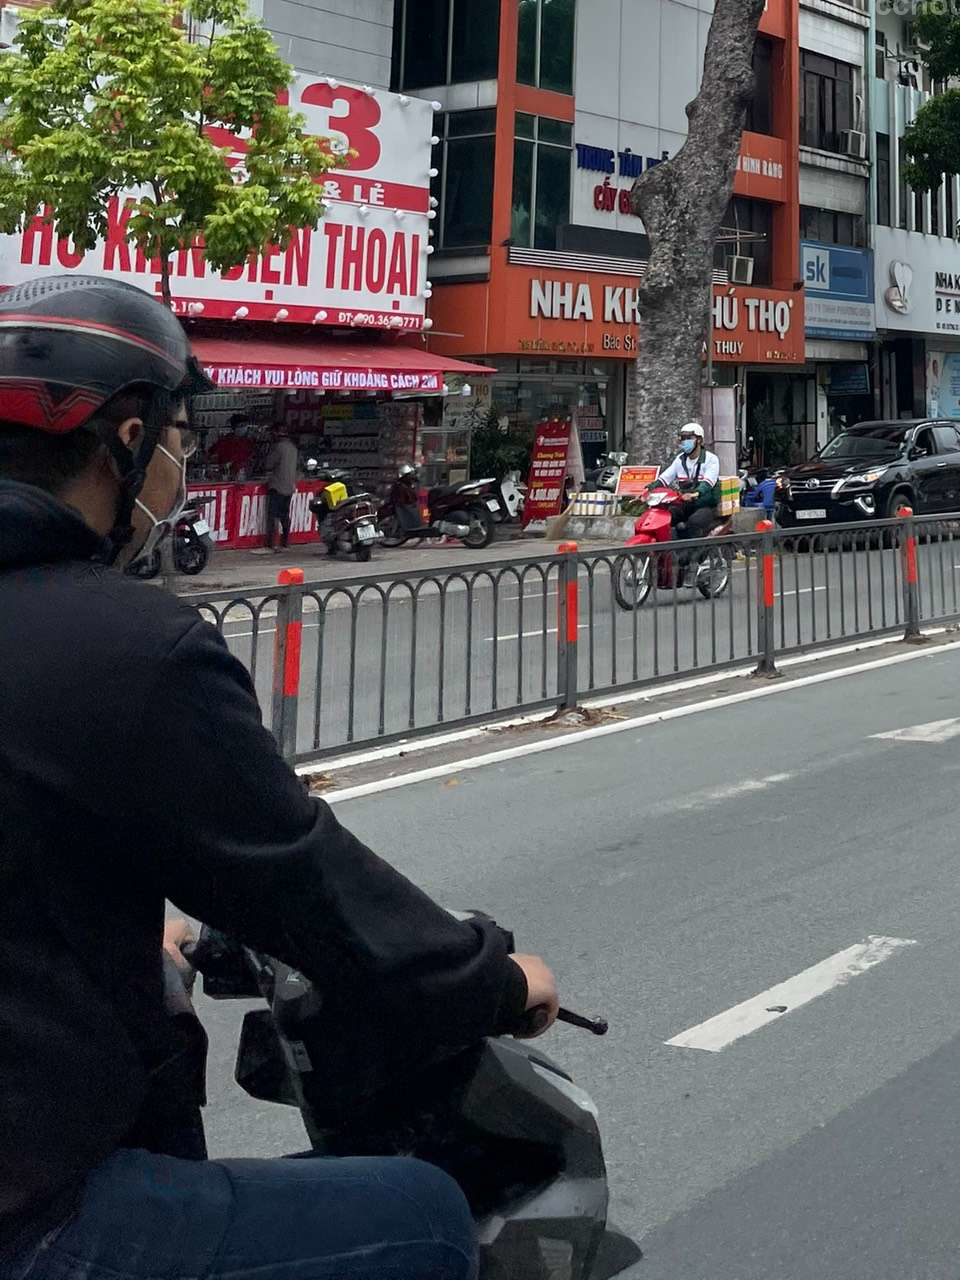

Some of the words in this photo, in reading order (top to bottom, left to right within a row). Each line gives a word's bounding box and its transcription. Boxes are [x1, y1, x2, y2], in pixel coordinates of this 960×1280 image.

[322, 181, 342, 199] &
[353, 183, 385, 206] LẺ
[324, 222, 420, 310] THOẠI
[806, 255, 826, 283] sk
[935, 271, 953, 289] NHA
[530, 279, 594, 321] NHA
[603, 285, 641, 324] KH
[711, 287, 738, 331] HÚ
[217, 365, 261, 386] KHÁCH
[264, 370, 285, 386] VUI
[287, 368, 319, 387] LÒNG
[343, 368, 389, 389] KHOẢNG
[390, 370, 419, 390] CÁCH
